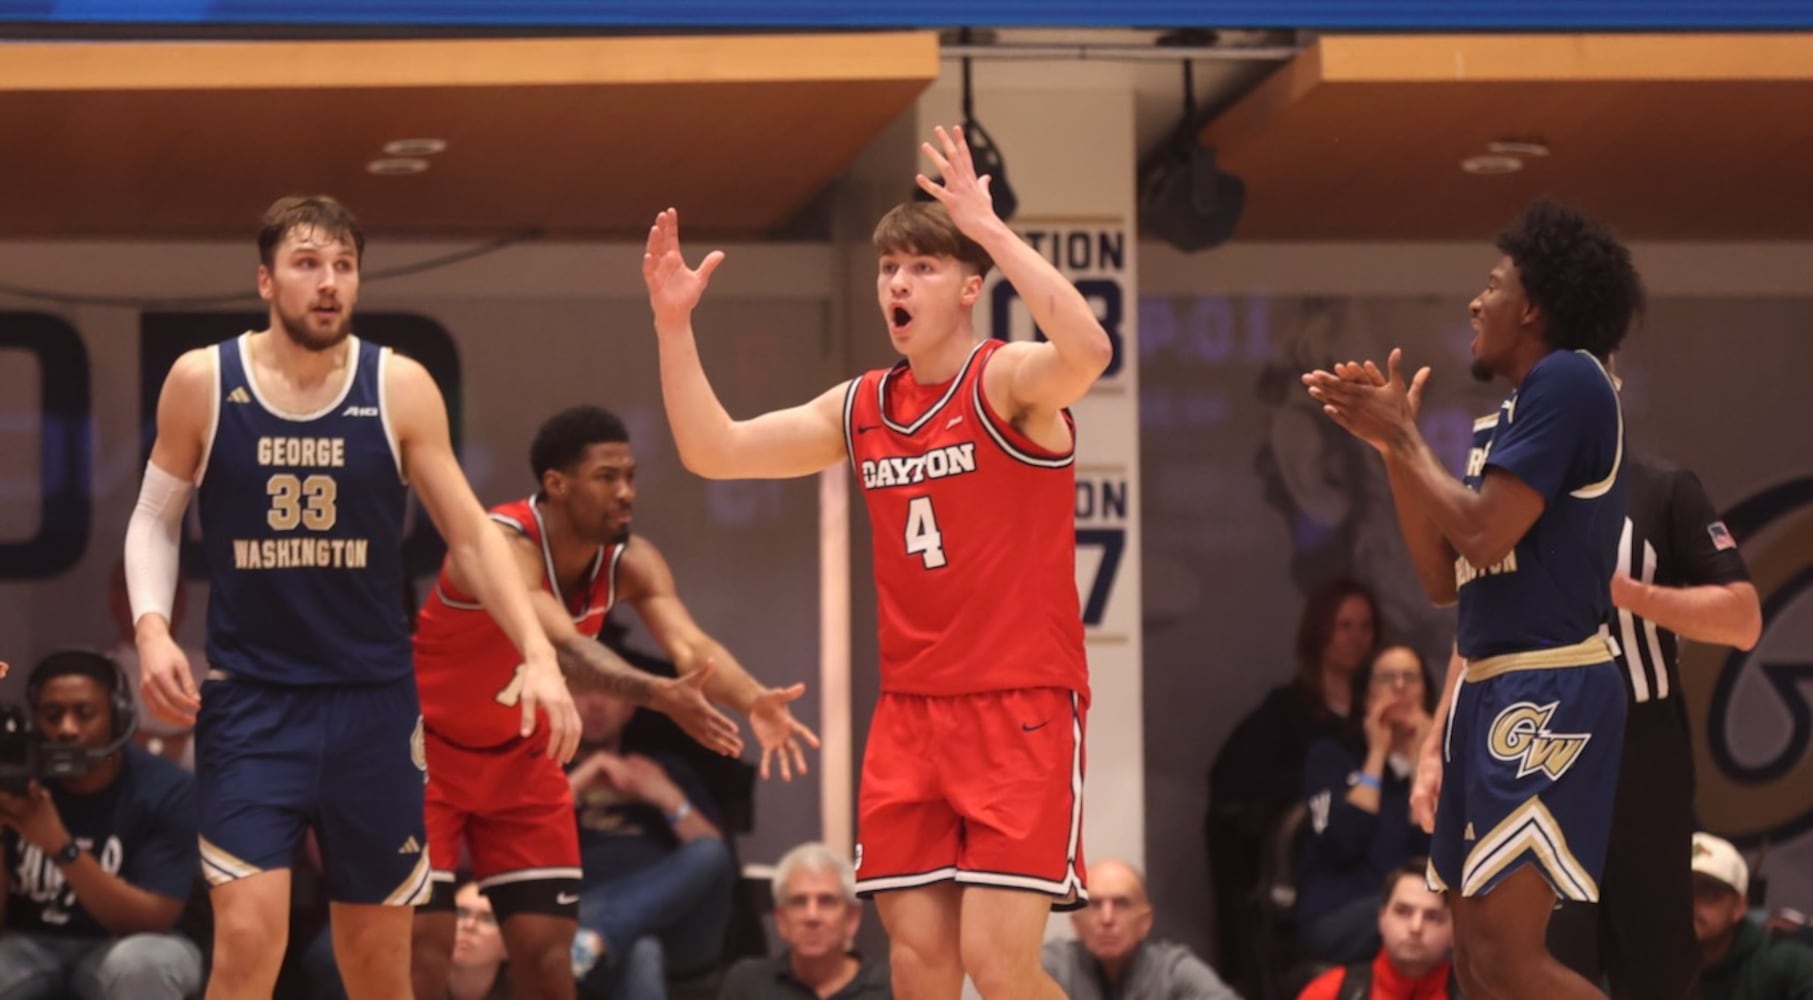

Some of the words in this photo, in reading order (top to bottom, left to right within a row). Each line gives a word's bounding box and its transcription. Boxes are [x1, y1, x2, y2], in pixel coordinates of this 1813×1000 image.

[257, 436, 345, 467] GEORGE
[861, 441, 977, 490] DAYTON
[266, 473, 337, 531] 33
[232, 538, 368, 569] WASHINGTON
[905, 495, 948, 570] 4
[1487, 700, 1593, 781] GW
